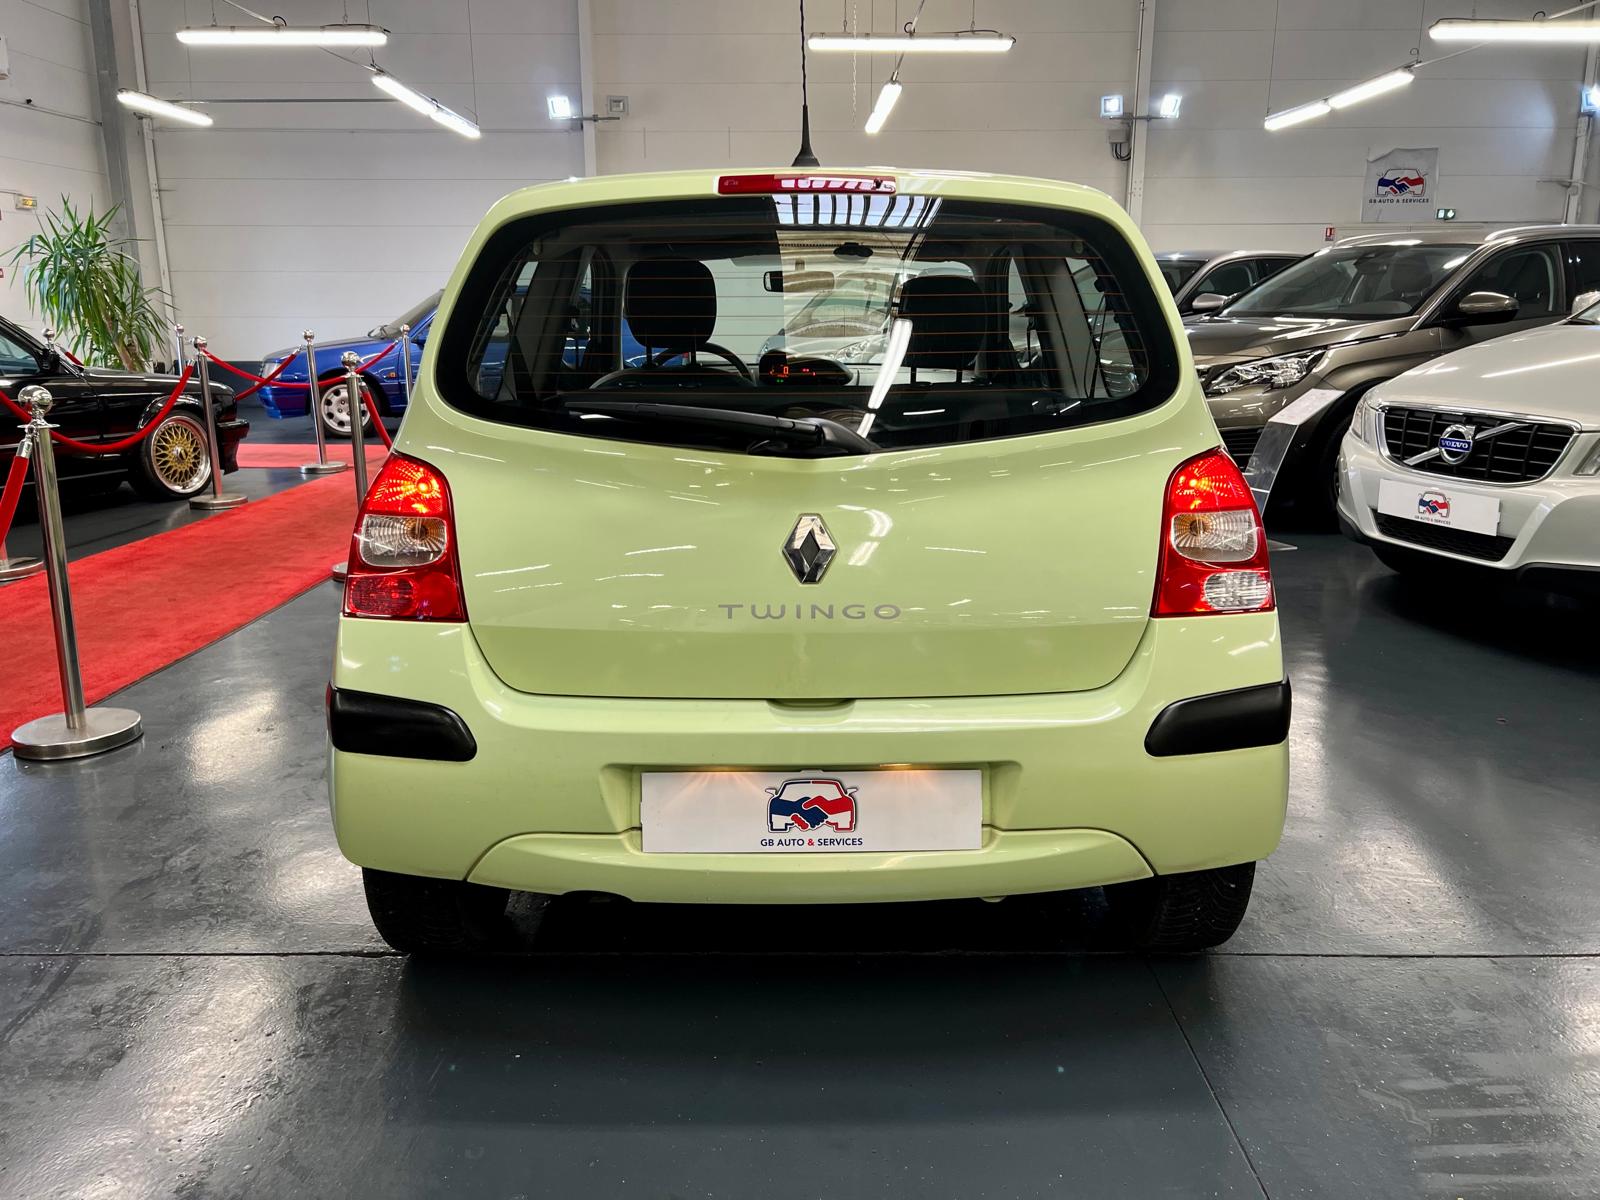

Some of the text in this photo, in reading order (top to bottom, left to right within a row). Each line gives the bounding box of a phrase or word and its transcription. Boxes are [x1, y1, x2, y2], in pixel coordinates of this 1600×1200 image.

[1440, 440, 1469, 449] VOLVO
[718, 604, 902, 620] TWINGO
[760, 837, 864, 847] GB AUTO & SERVICES
